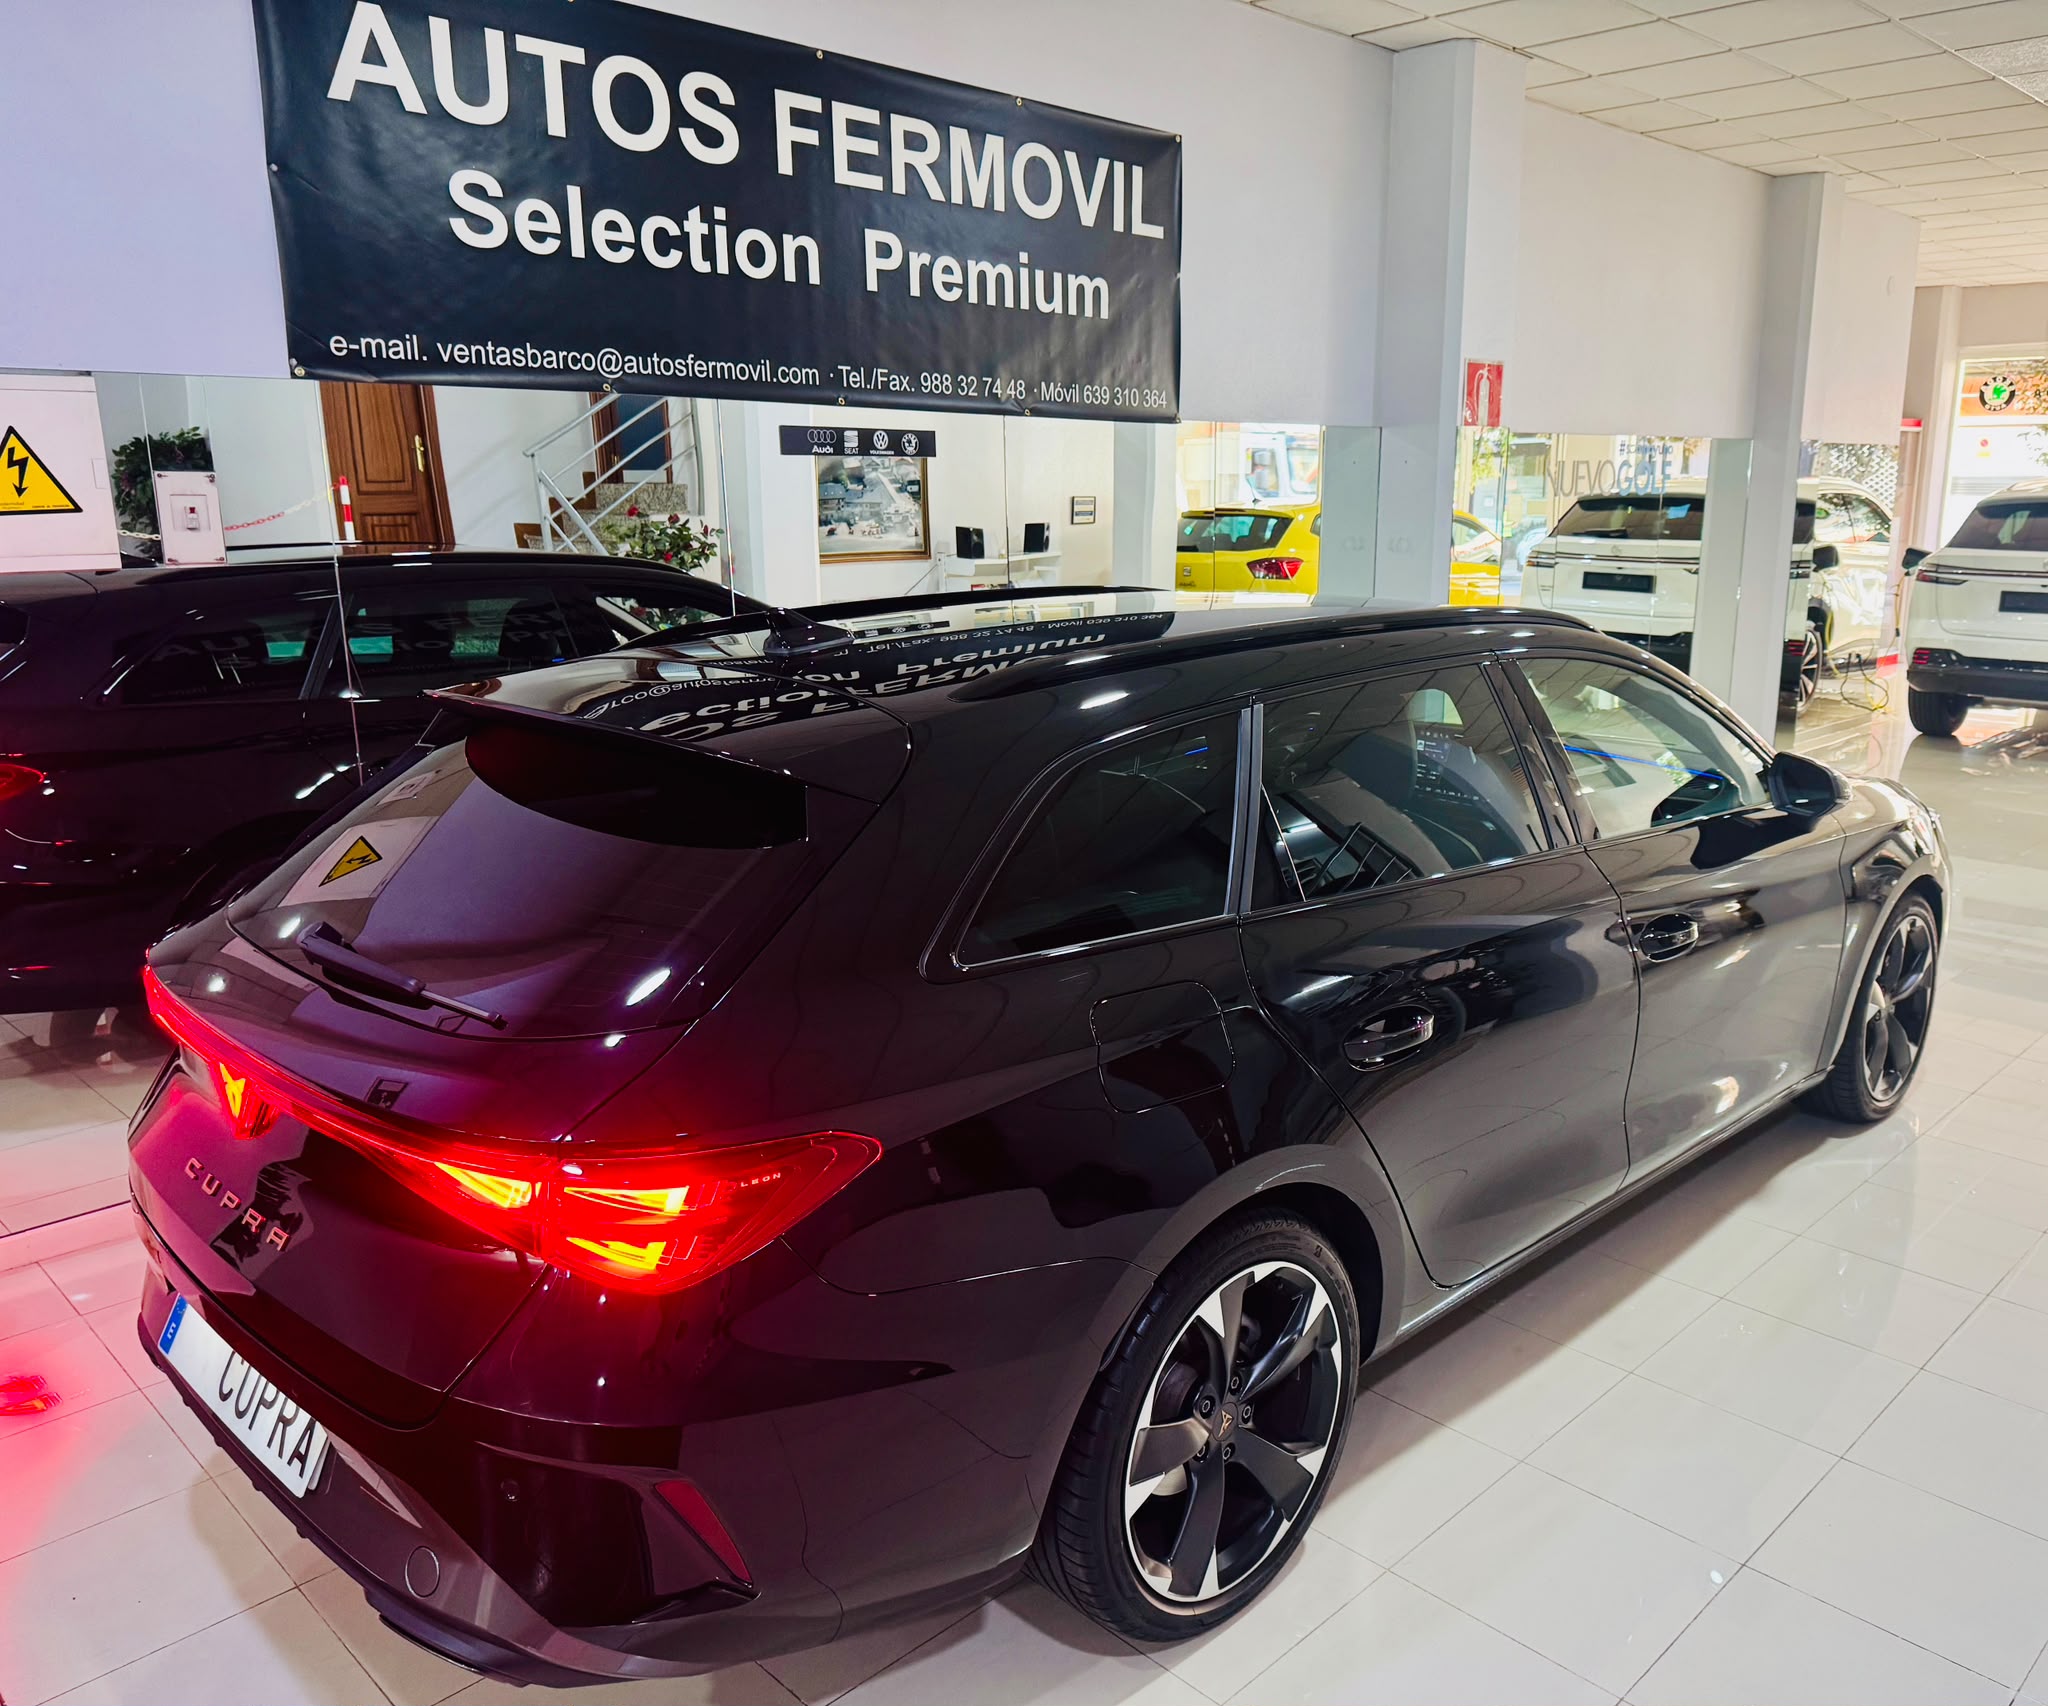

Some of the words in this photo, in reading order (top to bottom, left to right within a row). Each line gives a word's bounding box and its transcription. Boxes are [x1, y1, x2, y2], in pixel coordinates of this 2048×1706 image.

[327, 0, 741, 166] AUTOS
[773, 88, 1165, 240] FERMOVIL
[448, 169, 822, 285] Selection
[864, 228, 1110, 320] Premium
[329, 334, 429, 363] e-mail.
[437, 341, 820, 386] ventasbarco@autosfermovil.com
[920, 372, 952, 395] 988
[957, 376, 979, 397] 32
[982, 377, 1003, 398] 74
[1006, 379, 1026, 399] 48
[1083, 385, 1110, 406] 639
[1114, 387, 1139, 407] 310
[1143, 389, 1167, 409] 364
[812, 444, 834, 454] Audi
[844, 447, 860, 455] SEAT
[184, 1157, 290, 1251] CUPRA
[740, 1172, 782, 1188] LEON
[217, 1350, 318, 1479] CUPRA
